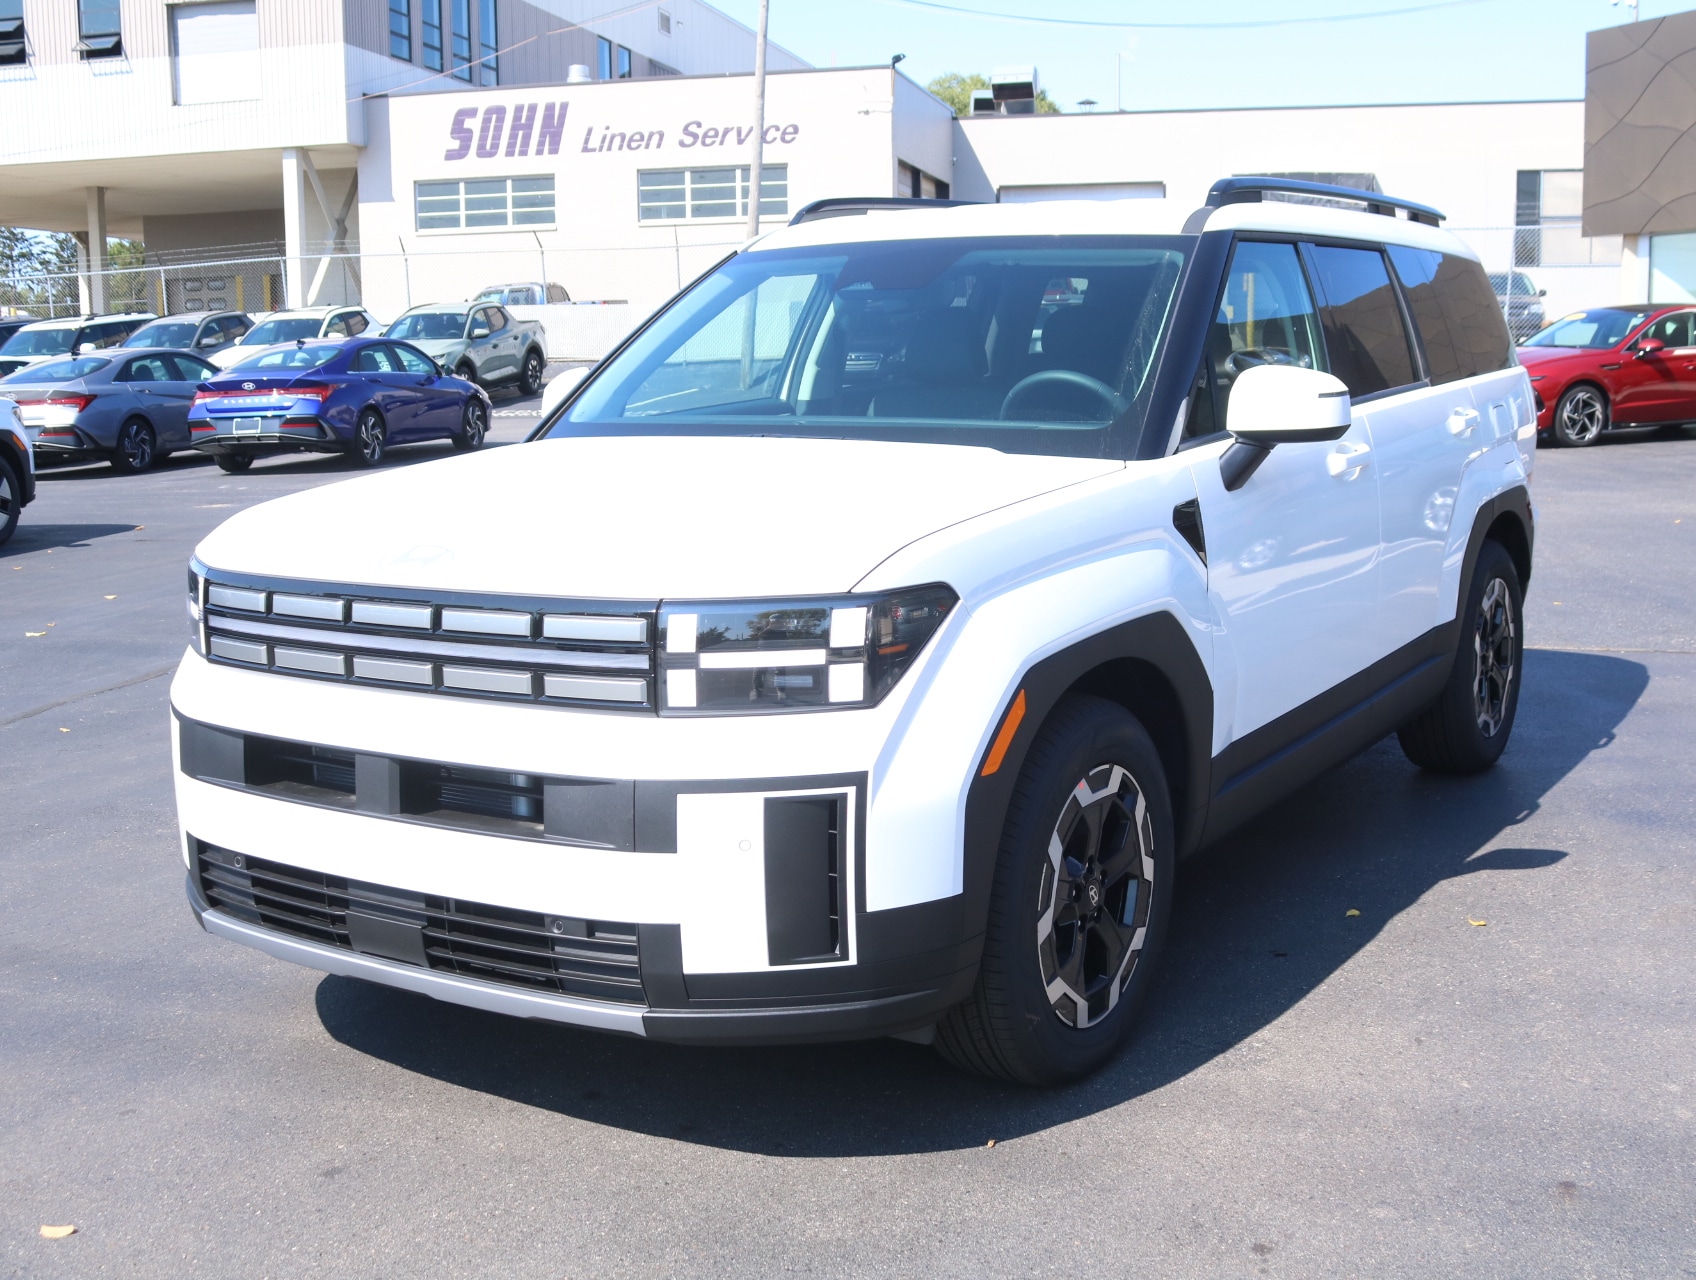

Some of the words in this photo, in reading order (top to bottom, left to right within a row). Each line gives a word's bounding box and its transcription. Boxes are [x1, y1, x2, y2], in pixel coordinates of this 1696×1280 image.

[444, 101, 569, 161] SOHN
[580, 125, 665, 153] Linen
[678, 120, 800, 148] Servce
